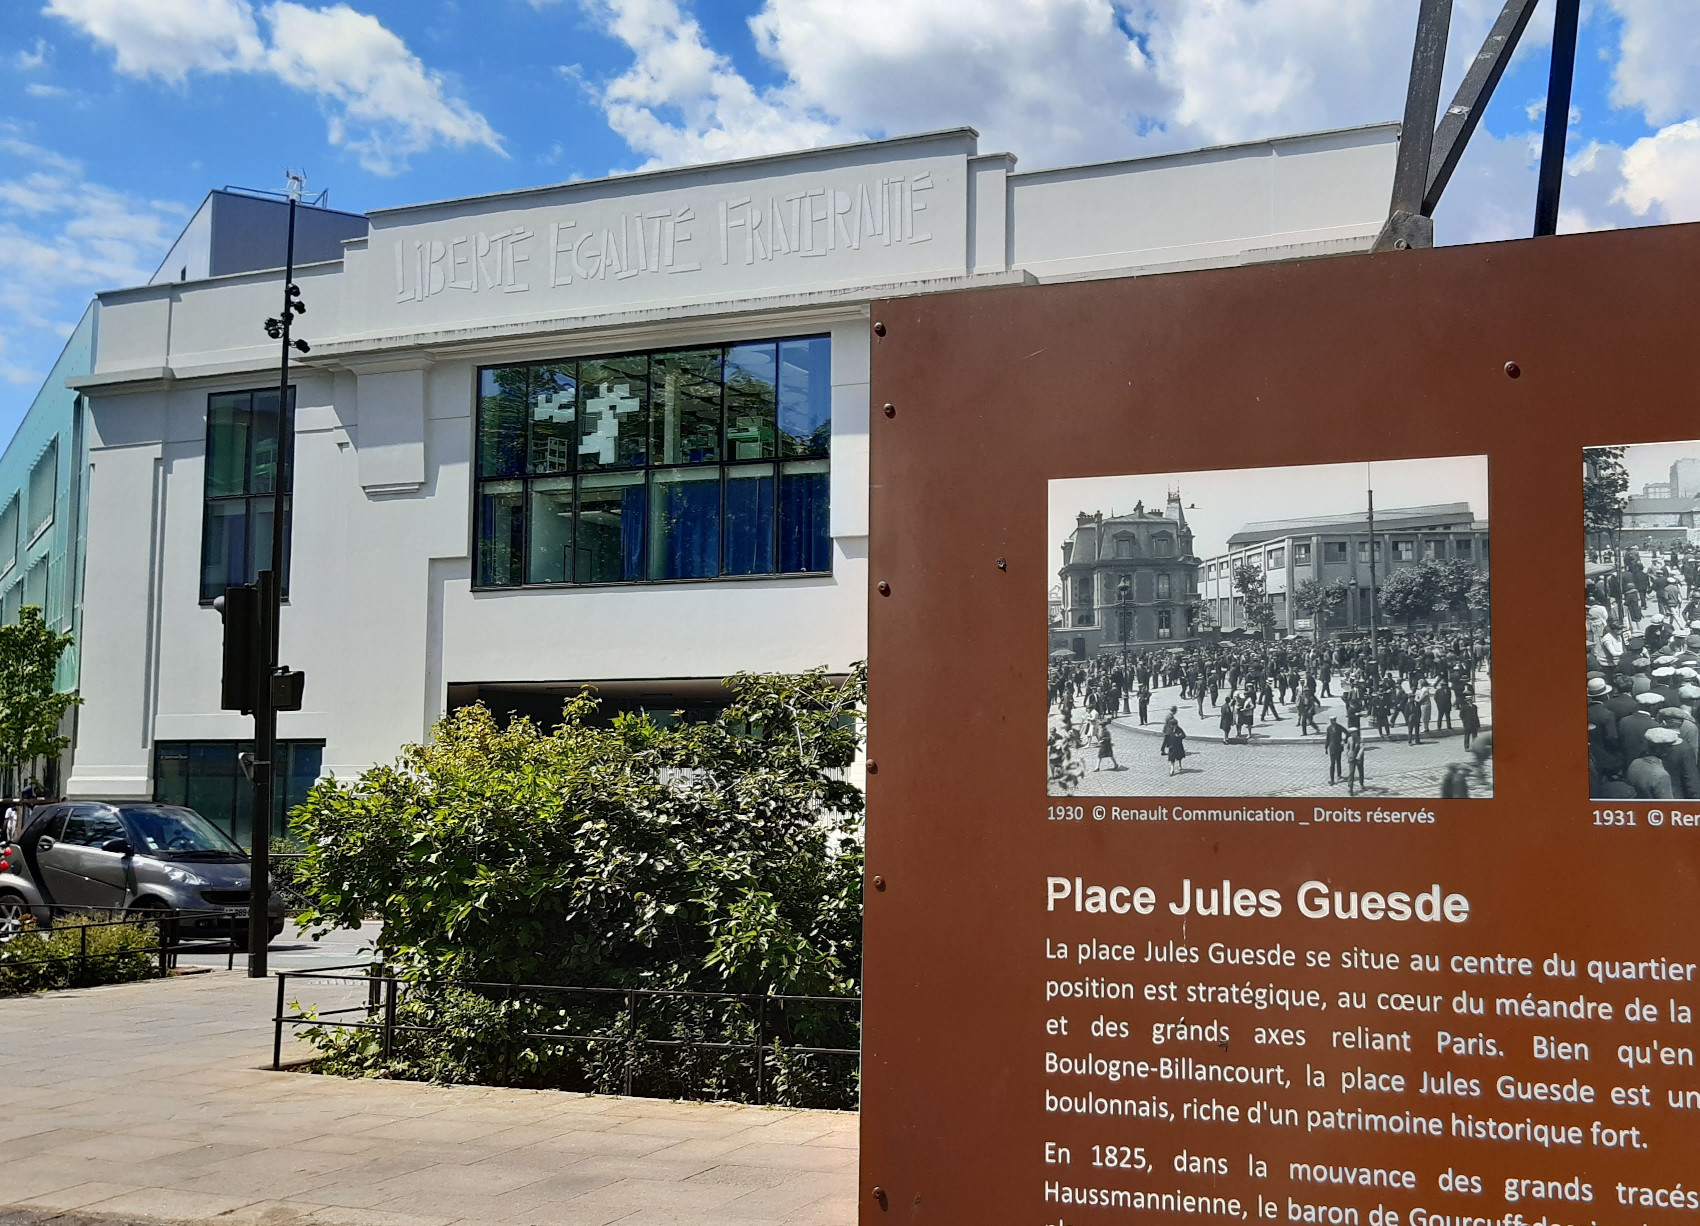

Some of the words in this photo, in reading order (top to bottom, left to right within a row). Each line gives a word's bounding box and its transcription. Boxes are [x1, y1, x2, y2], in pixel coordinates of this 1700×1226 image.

[1047, 805, 1084, 821] 1930
[1111, 805, 1169, 821] Renault
[1171, 806, 1295, 823] Communication
[1313, 806, 1362, 823] Droits
[1366, 806, 1436, 824] réservés
[1592, 809, 1638, 827] 1931
[1046, 876, 1157, 915] Place
[1168, 878, 1283, 918] Jules
[1296, 880, 1471, 924] Guesde
[1045, 937, 1068, 960] La
[1077, 937, 1136, 965] place
[1143, 939, 1200, 964] Jules
[1207, 941, 1296, 967] Guesde
[1305, 950, 1332, 968] se
[1340, 946, 1400, 971] situe
[1409, 953, 1441, 973] au
[1450, 953, 1535, 977] centre
[1542, 952, 1578, 979] du
[1586, 956, 1699, 985] quartier
[1046, 976, 1134, 1002] position
[1143, 980, 1178, 1003] est
[1186, 980, 1327, 1012] stratégique,
[1337, 991, 1367, 1009] au
[1376, 992, 1444, 1013] cœur
[1451, 989, 1487, 1017] du
[1495, 992, 1615, 1022] méandre
[1624, 996, 1660, 1024] de
[1669, 998, 1693, 1024] la
[1045, 1015, 1069, 1036] et
[1090, 1014, 1130, 1039] des
[1253, 1027, 1307, 1047] axes
[1332, 1025, 1412, 1053] reliant
[1437, 1030, 1506, 1059] Paris.
[1532, 1035, 1592, 1062] Bien
[1617, 1039, 1695, 1070] qu'en
[1045, 1051, 1291, 1090] Boulogne-Billancourt,
[1306, 1063, 1326, 1089] la
[1341, 1065, 1407, 1095] place
[1418, 1070, 1483, 1099] Jules
[1496, 1075, 1597, 1105] Guesde
[1610, 1084, 1653, 1109] est
[1045, 1088, 1175, 1123] boulonnais,
[1182, 1097, 1241, 1124] riche
[1246, 1100, 1299, 1127] d'un
[1306, 1107, 1445, 1137] patrimoine
[1451, 1111, 1585, 1149] historique
[1589, 1120, 1649, 1151] fort.
[1044, 1141, 1071, 1166] En
[1091, 1144, 1153, 1175] 1825,
[1173, 1148, 1229, 1176] dans
[1248, 1152, 1268, 1180] la
[1289, 1162, 1417, 1190] mouvance
[1437, 1167, 1484, 1196] des
[1504, 1175, 1595, 1204] grands
[1615, 1181, 1700, 1211] tracés
[1044, 1179, 1248, 1221] Haussmannienne,
[1257, 1193, 1278, 1220] le
[1287, 1196, 1360, 1226] baron
[1368, 1203, 1401, 1226] de
